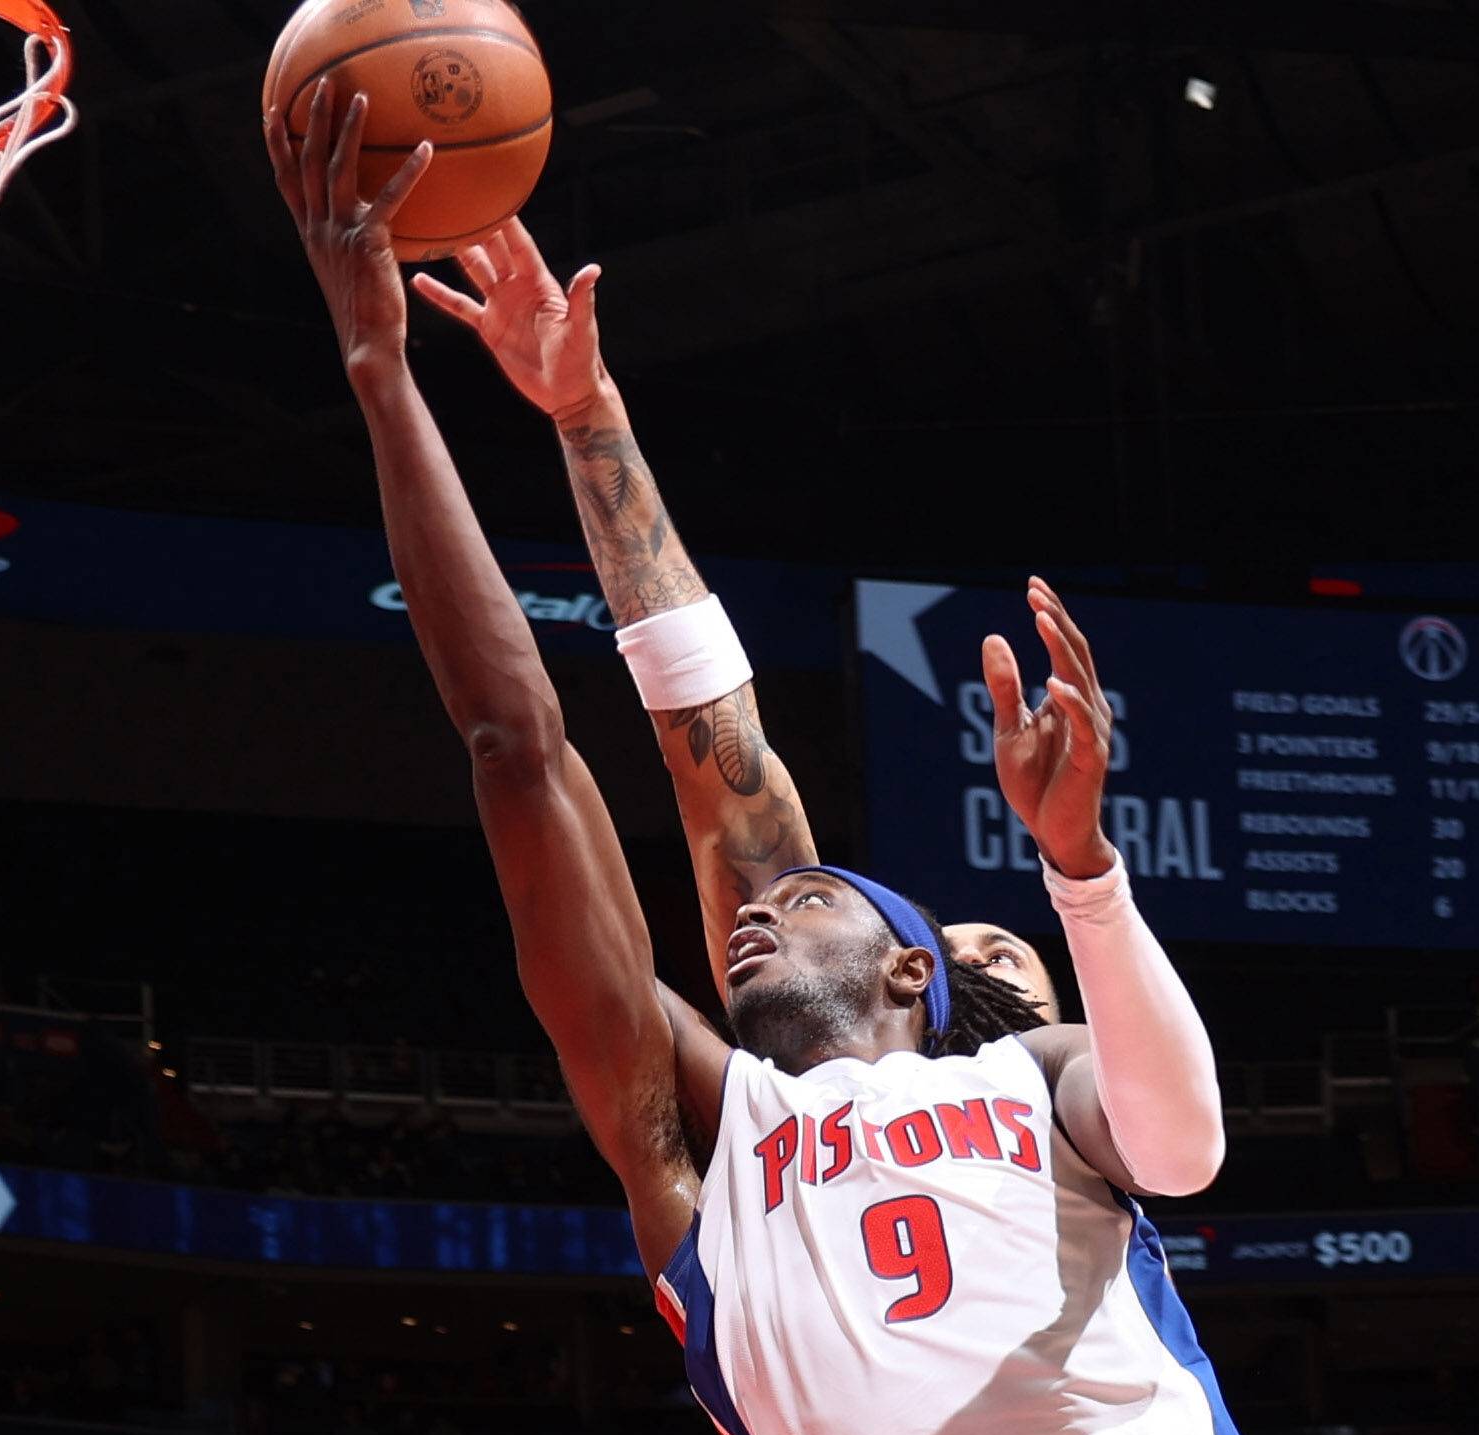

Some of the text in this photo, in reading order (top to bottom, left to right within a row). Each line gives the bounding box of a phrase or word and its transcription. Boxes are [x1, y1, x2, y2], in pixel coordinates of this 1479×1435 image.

[1232, 690, 1298, 714] FIELD
[1301, 693, 1382, 718] GOALS
[1256, 733, 1379, 760] POINTERS
[962, 786, 1225, 881] CERAL
[1239, 812, 1371, 839] REBOUNDS
[1244, 850, 1340, 875] ASSISTS
[1246, 888, 1339, 914] BLOCKS
[753, 1098, 1042, 1216] PISTONS
[861, 1194, 953, 1324] 9
[1312, 1230, 1412, 1269] $500
